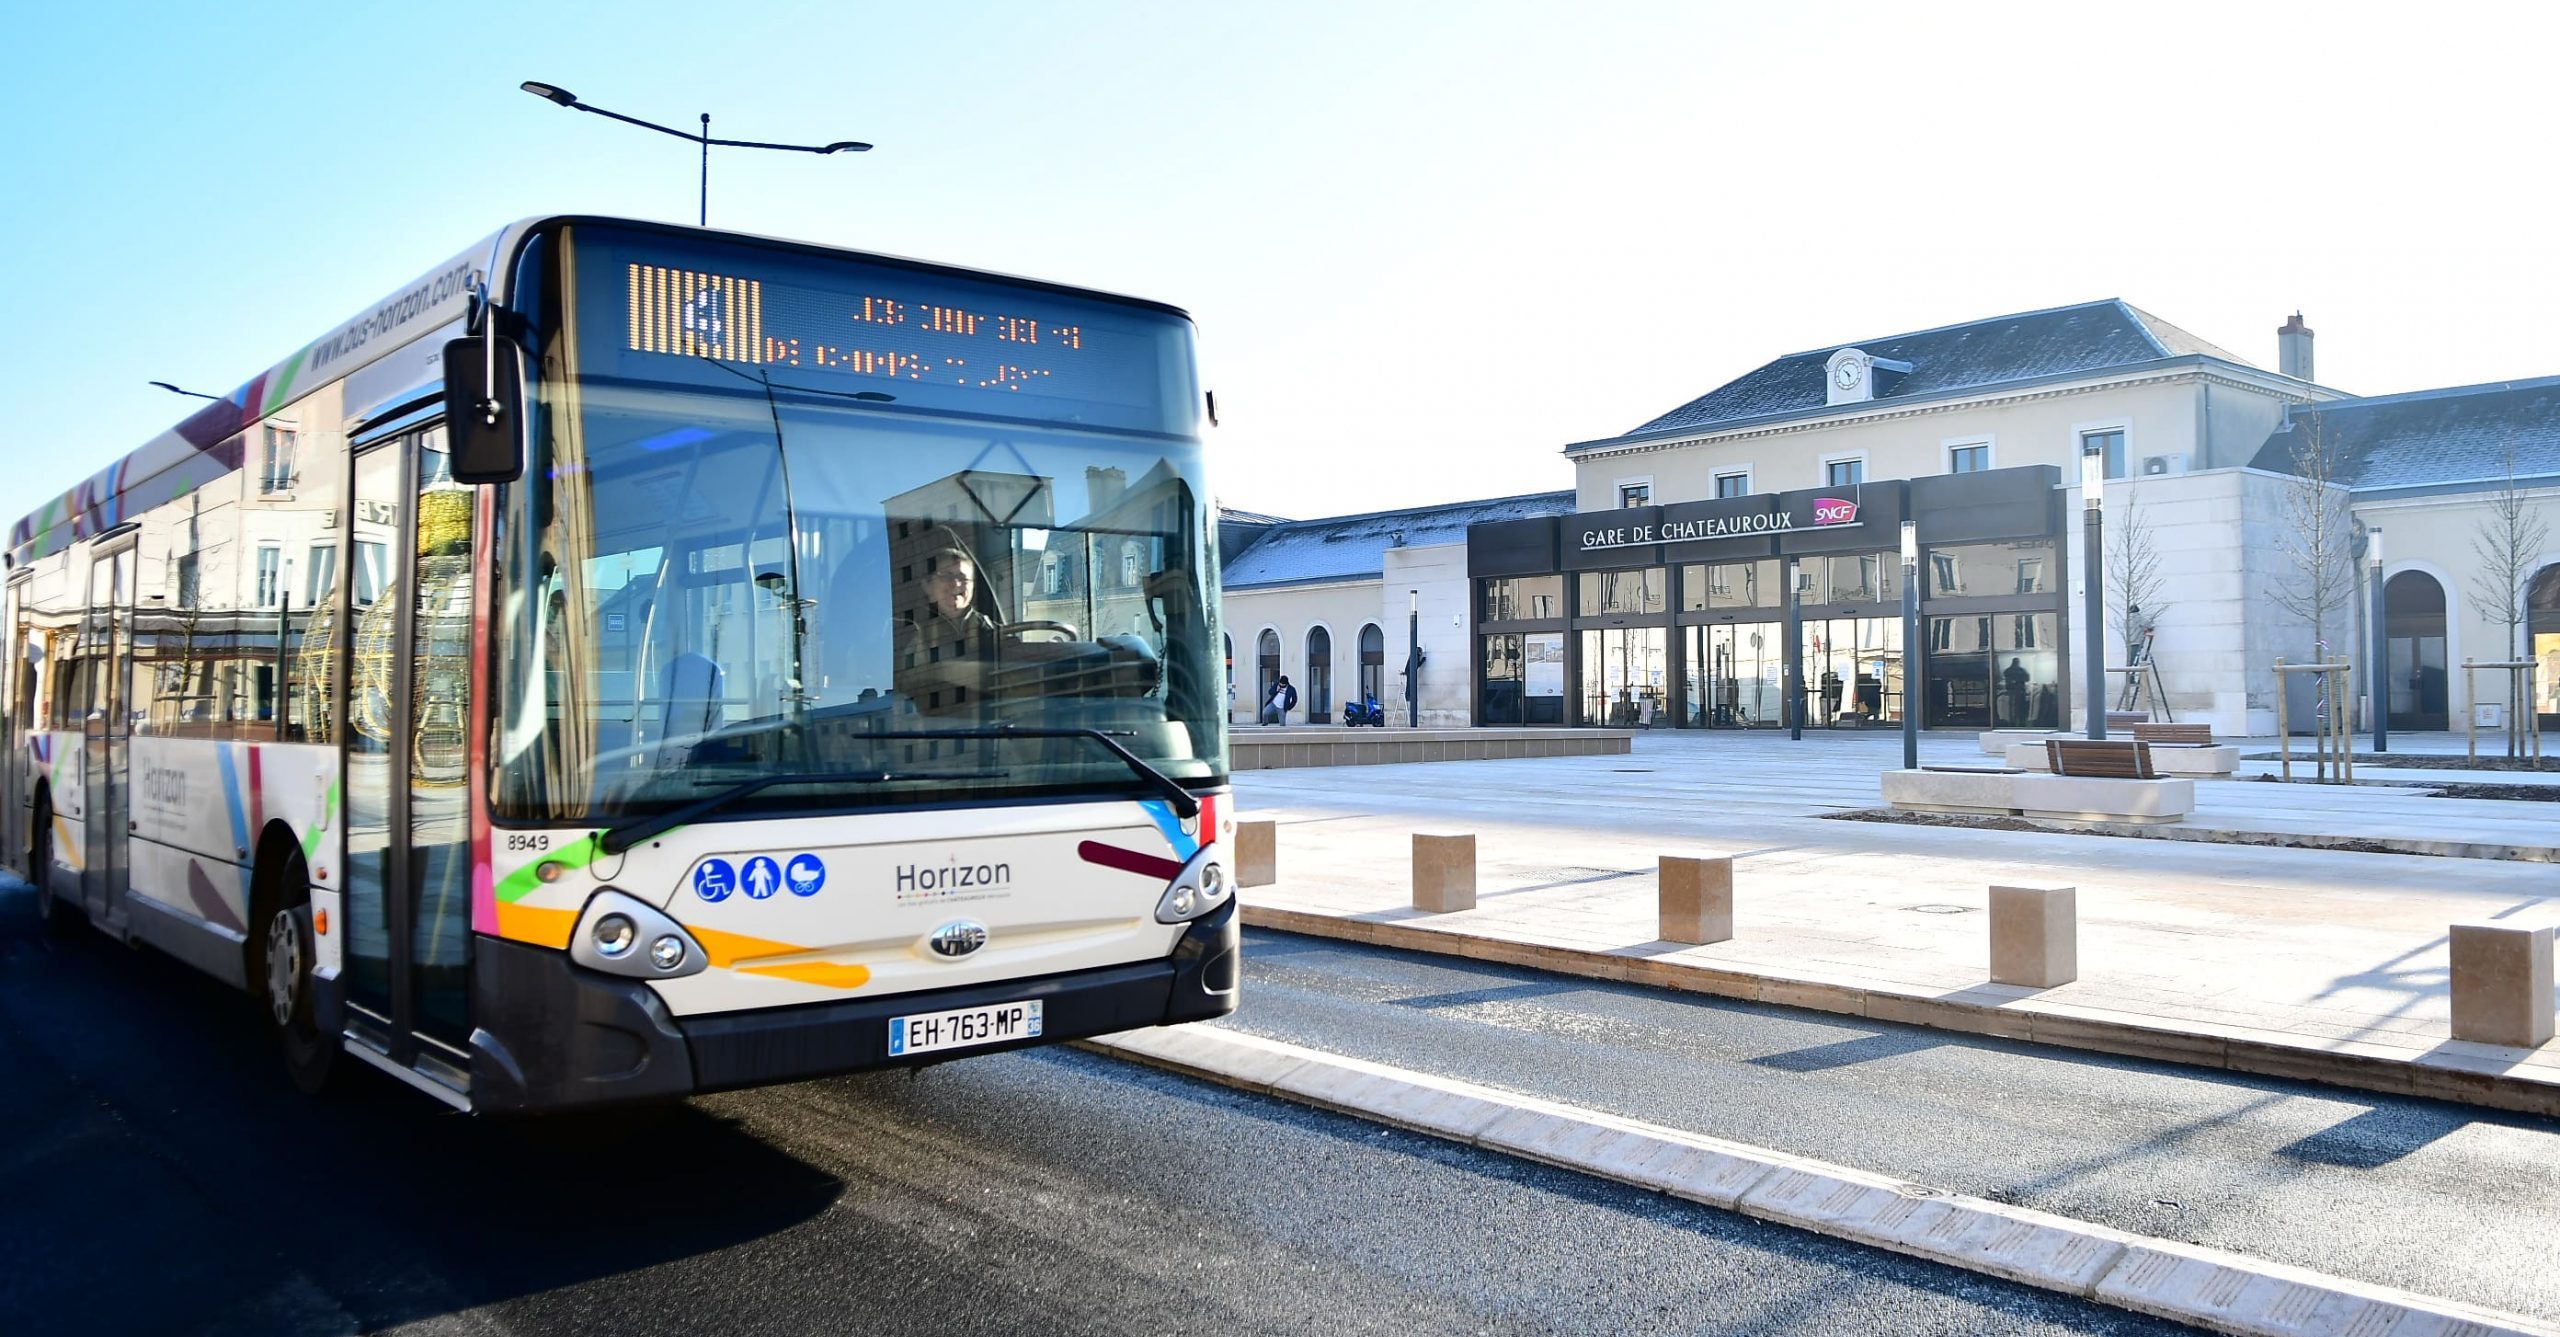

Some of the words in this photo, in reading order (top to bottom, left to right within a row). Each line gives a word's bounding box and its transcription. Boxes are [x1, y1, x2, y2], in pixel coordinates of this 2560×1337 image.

[312, 262, 469, 372] www.bus-horizon.com
[1582, 528, 1625, 546] GARE
[1633, 525, 1652, 542] DE
[1661, 512, 1791, 539] CHATEAUROUX
[1814, 505, 1853, 522] SNCF
[508, 835, 549, 851] 8949
[896, 863, 1010, 892] Horizon
[910, 1008, 1022, 1048] EH-763-MP
[1028, 1019, 1041, 1034] 36
